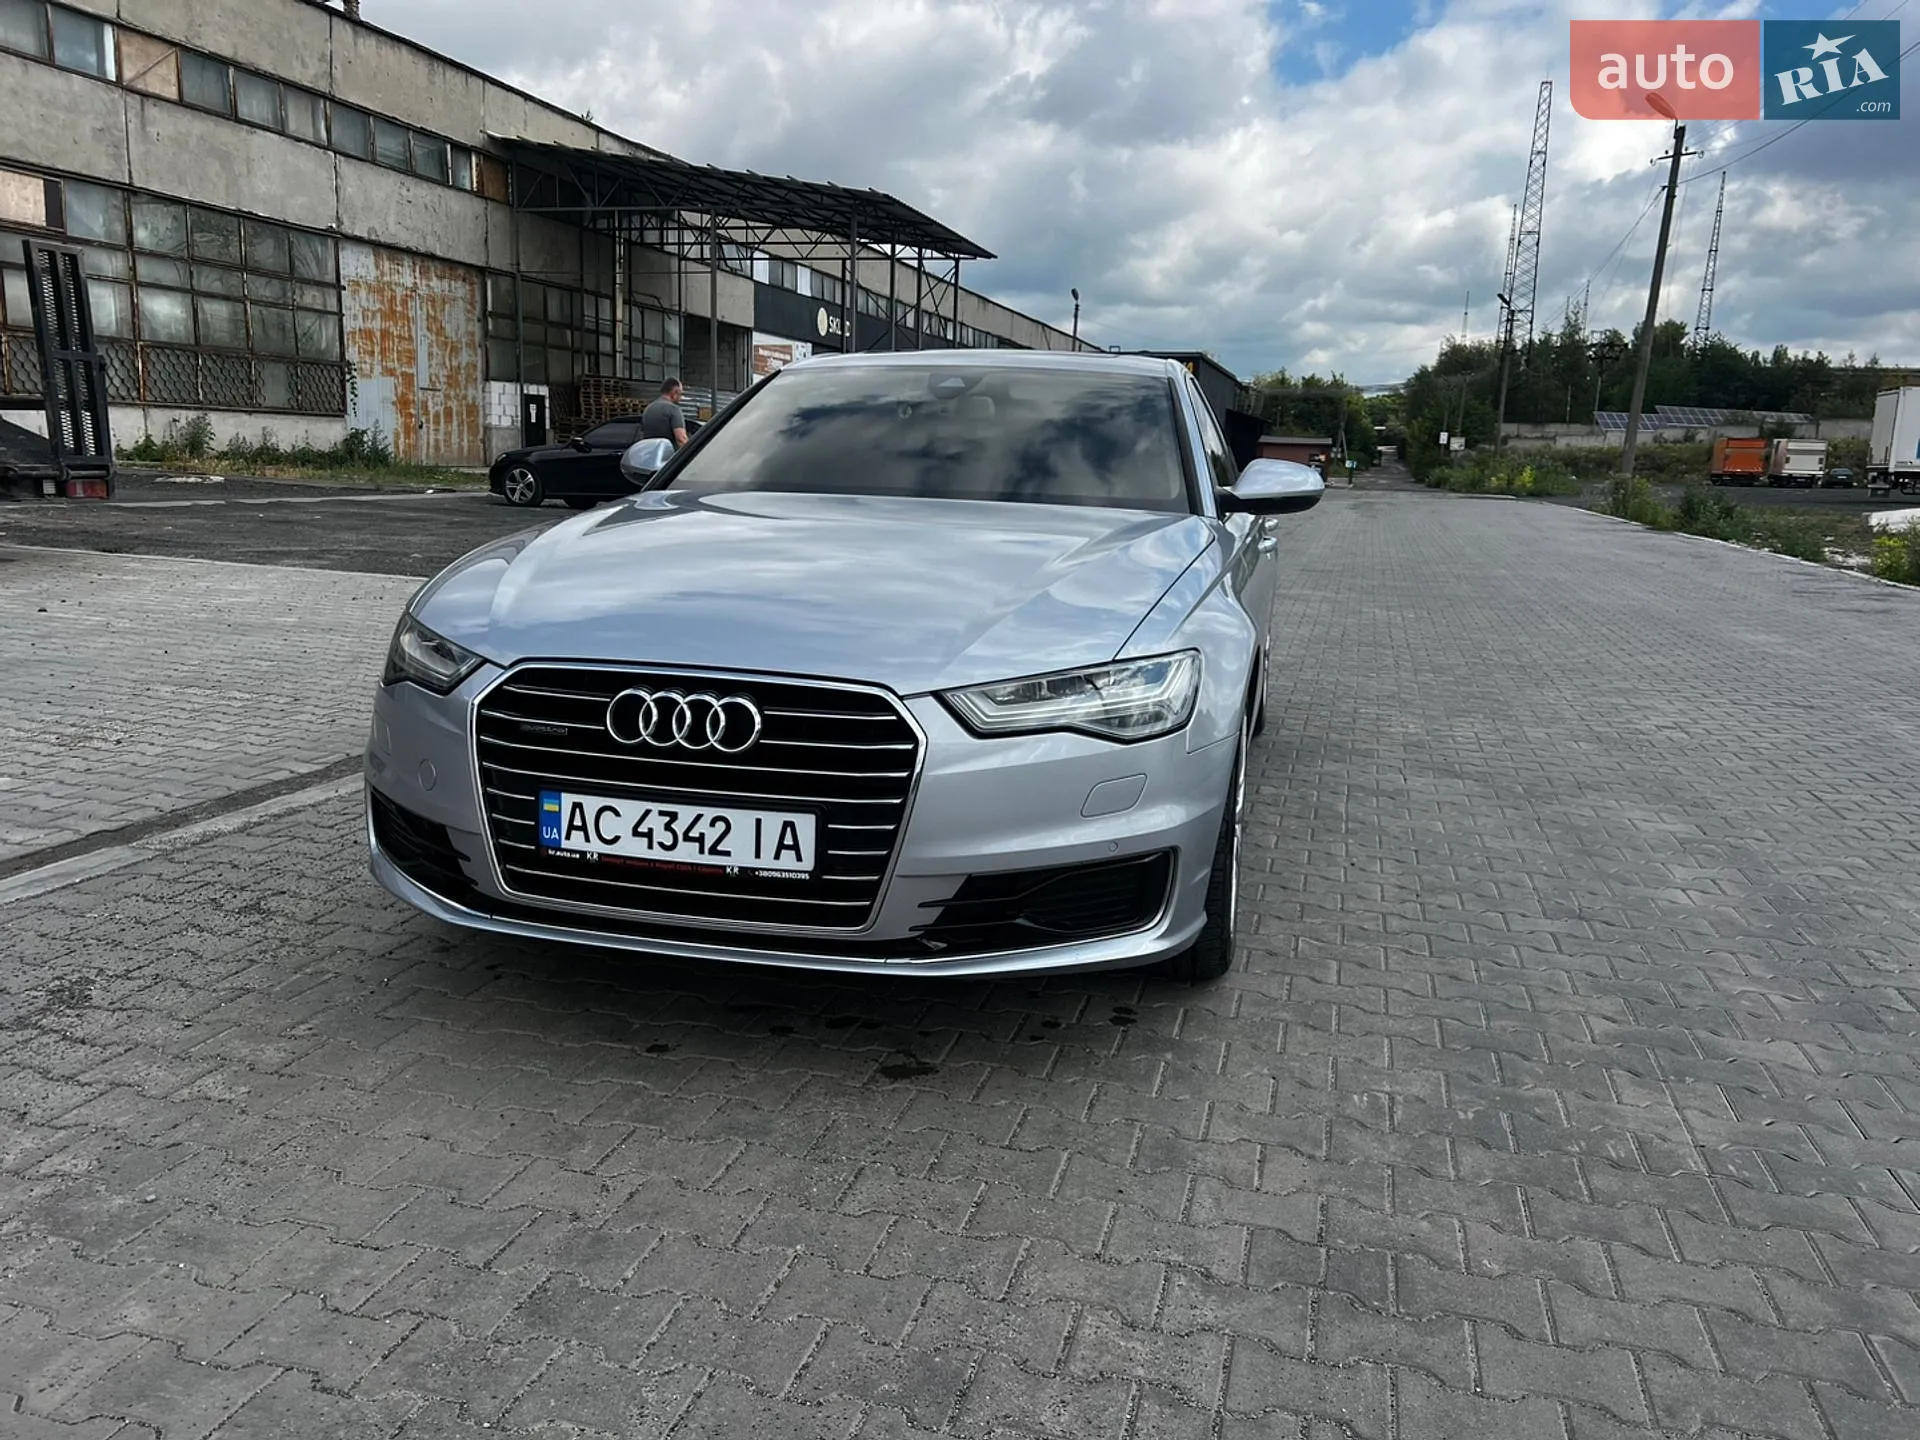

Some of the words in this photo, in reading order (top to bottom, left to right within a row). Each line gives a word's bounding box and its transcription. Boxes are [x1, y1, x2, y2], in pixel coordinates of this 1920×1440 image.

[542, 825, 559, 840] UA
[564, 801, 622, 846] AC
[631, 809, 732, 857] 4342
[754, 817, 804, 863] IA
